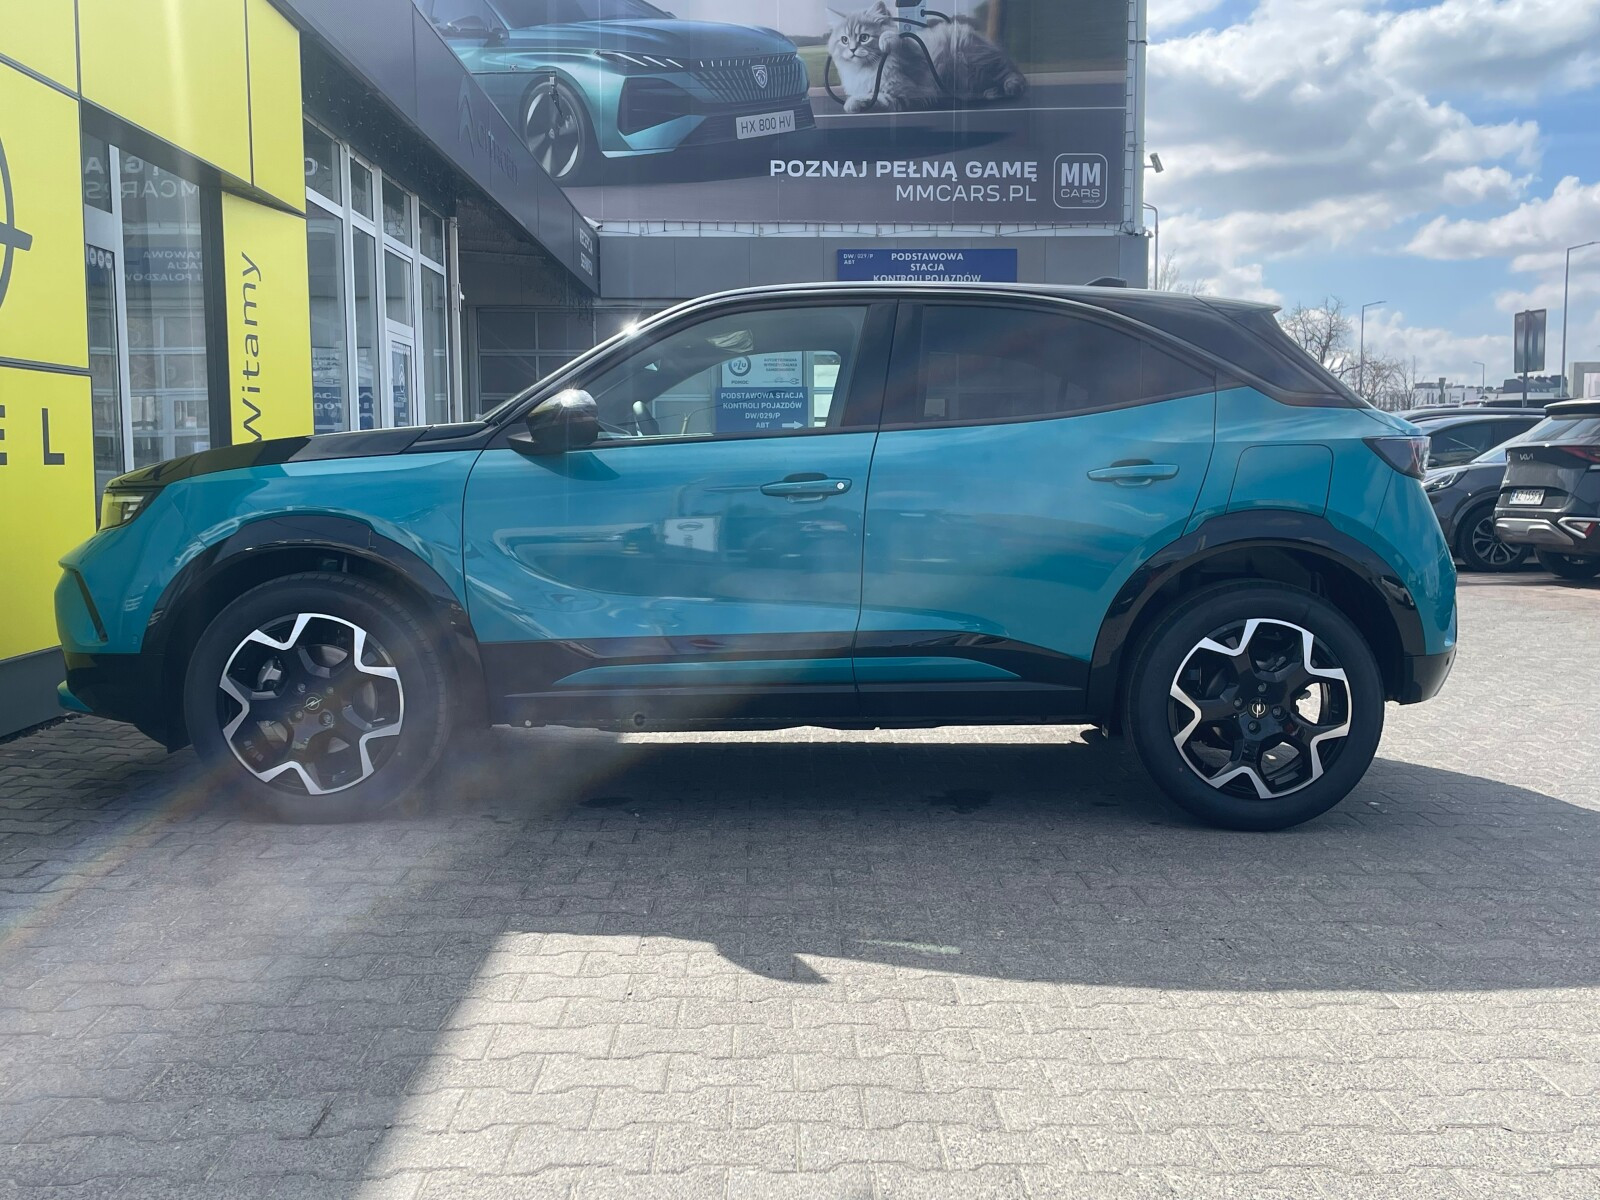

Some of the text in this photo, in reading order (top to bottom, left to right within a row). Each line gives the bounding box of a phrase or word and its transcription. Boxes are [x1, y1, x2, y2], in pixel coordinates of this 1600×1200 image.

[741, 115, 792, 134] HX 800 HV
[770, 160, 1038, 182] POZNAJ PEŁNĄ GAMĘ
[1060, 162, 1101, 187] MM
[896, 184, 1037, 202] MMCARS.PL
[1060, 188, 1101, 198] CARS
[891, 252, 964, 261] PODSTAWOWA
[910, 263, 945, 271] STACJA
[925, 272, 982, 282] POJAZDÓW
[761, 400, 802, 409] POJAZDÓW
[745, 412, 781, 420] DW/029/P
